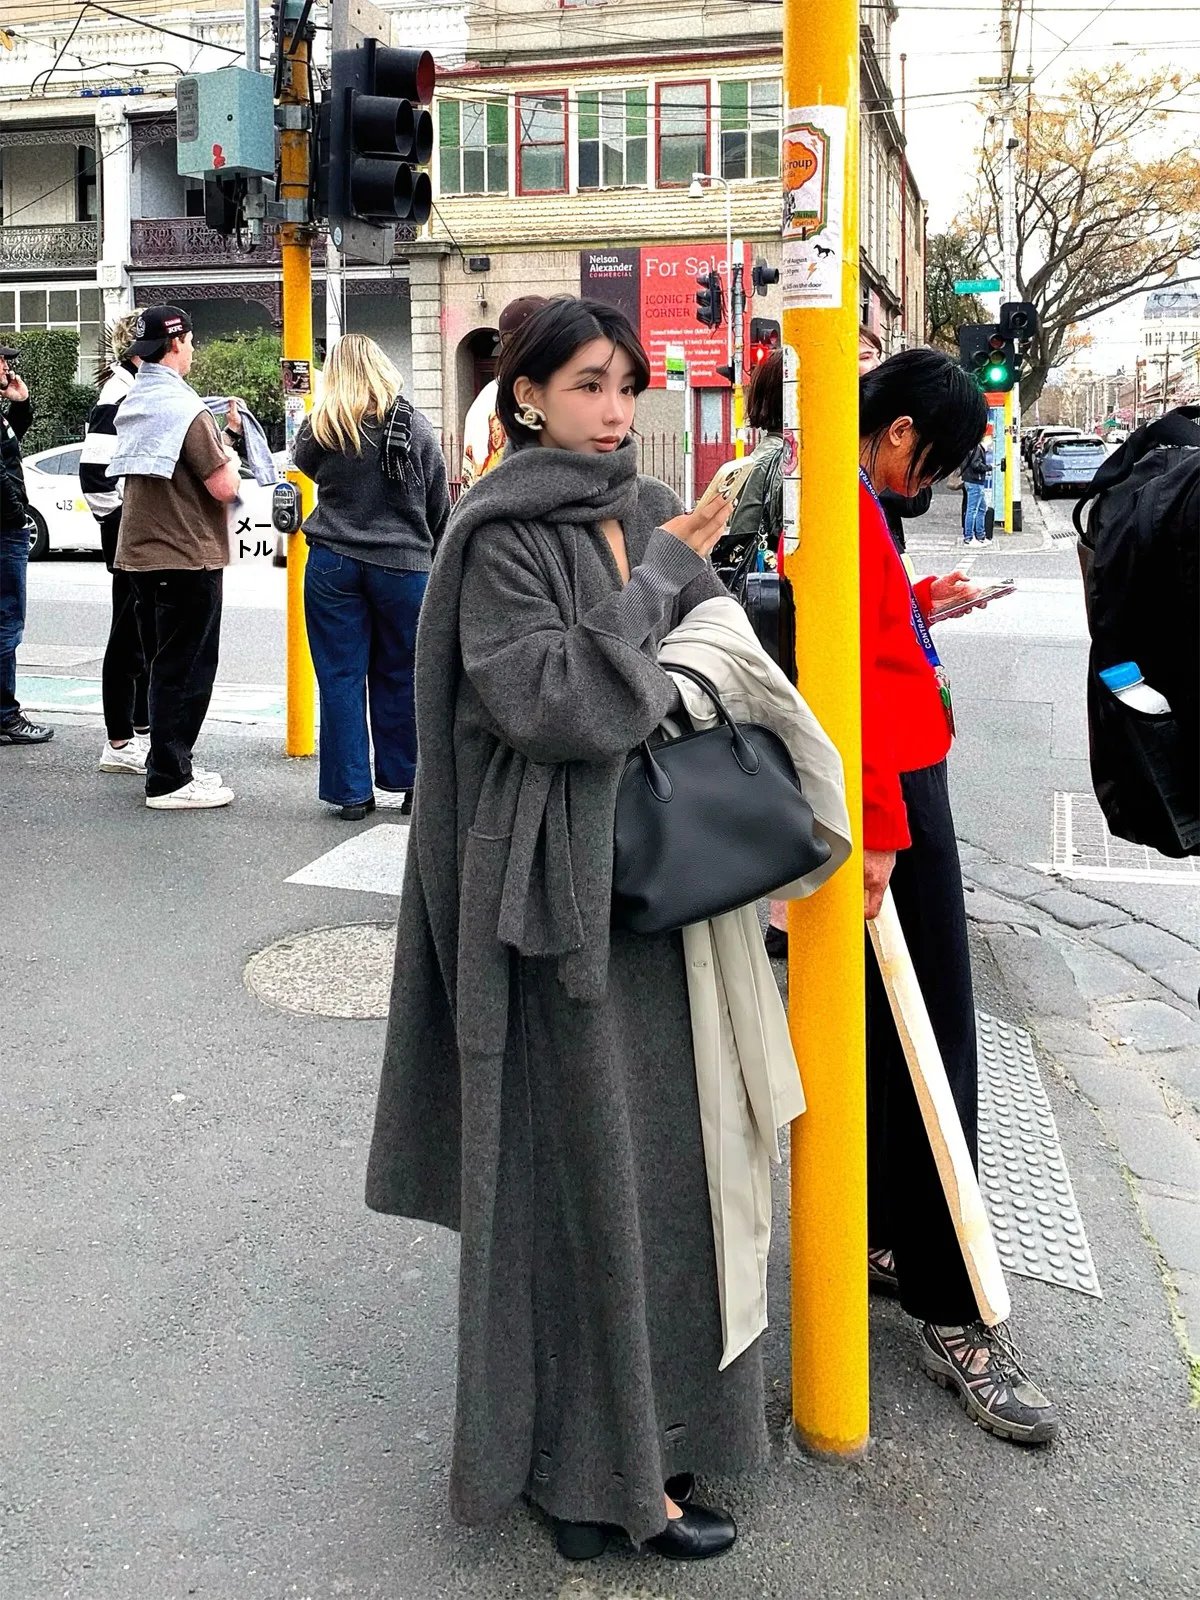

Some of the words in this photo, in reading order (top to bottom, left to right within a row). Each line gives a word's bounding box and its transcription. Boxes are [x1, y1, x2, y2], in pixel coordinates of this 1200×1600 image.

[589, 255, 619, 264] Nelson
[589, 263, 633, 272] Alexander
[645, 258, 680, 277] For
[685, 255, 728, 276] Sale
[645, 295, 683, 305] ICONIC
[645, 308, 690, 318] CORNER
[63, 500, 73, 511] 13
